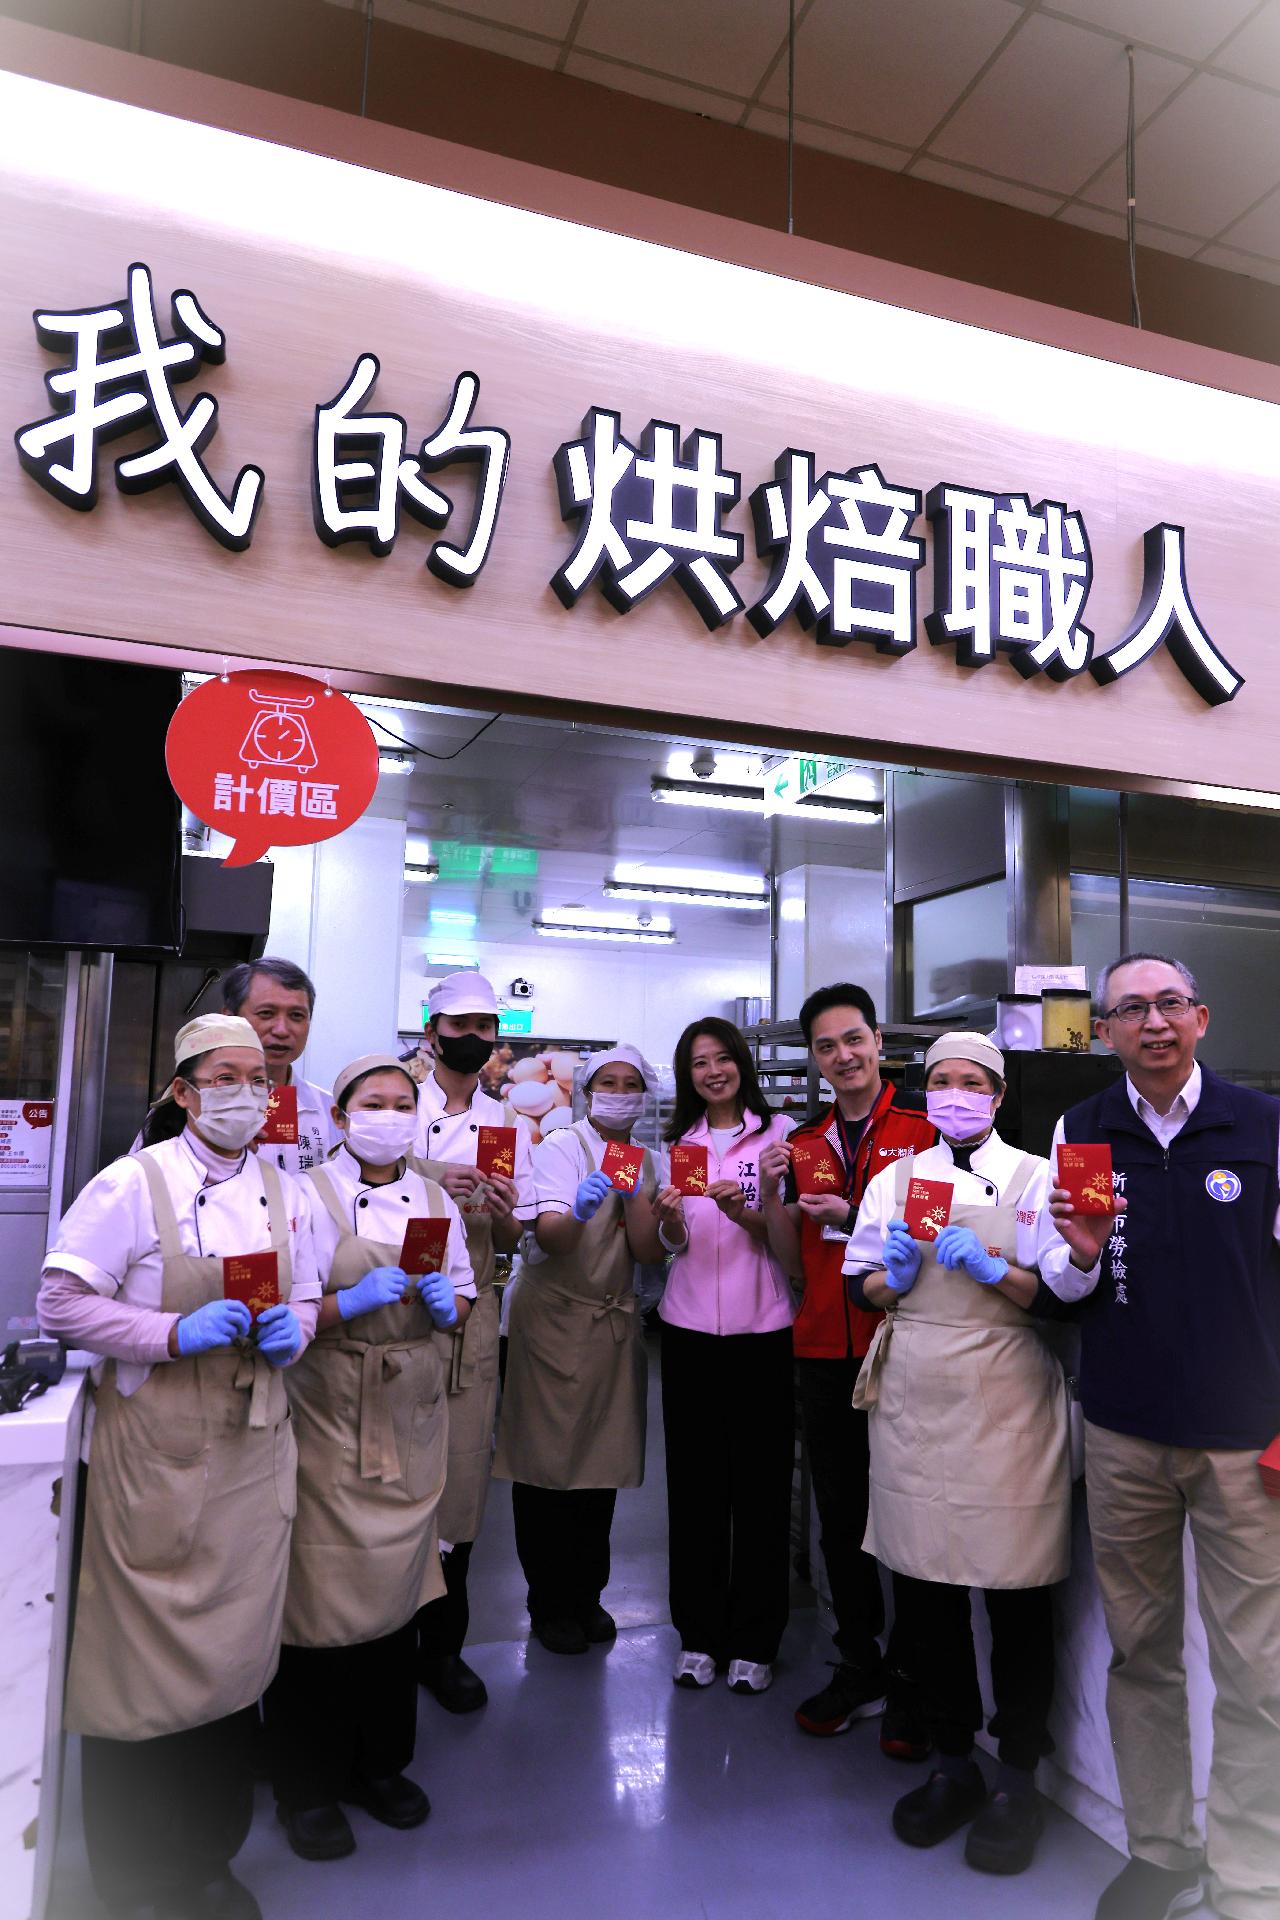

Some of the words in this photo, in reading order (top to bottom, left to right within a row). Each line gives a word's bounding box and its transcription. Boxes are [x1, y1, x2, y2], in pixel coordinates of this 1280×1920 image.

[16, 262, 1245, 706] 我的烘焙職人
[213, 772, 340, 820] 計價區
[28, 1109, 48, 1119] 公告
[737, 1161, 757, 1208] 江怡
